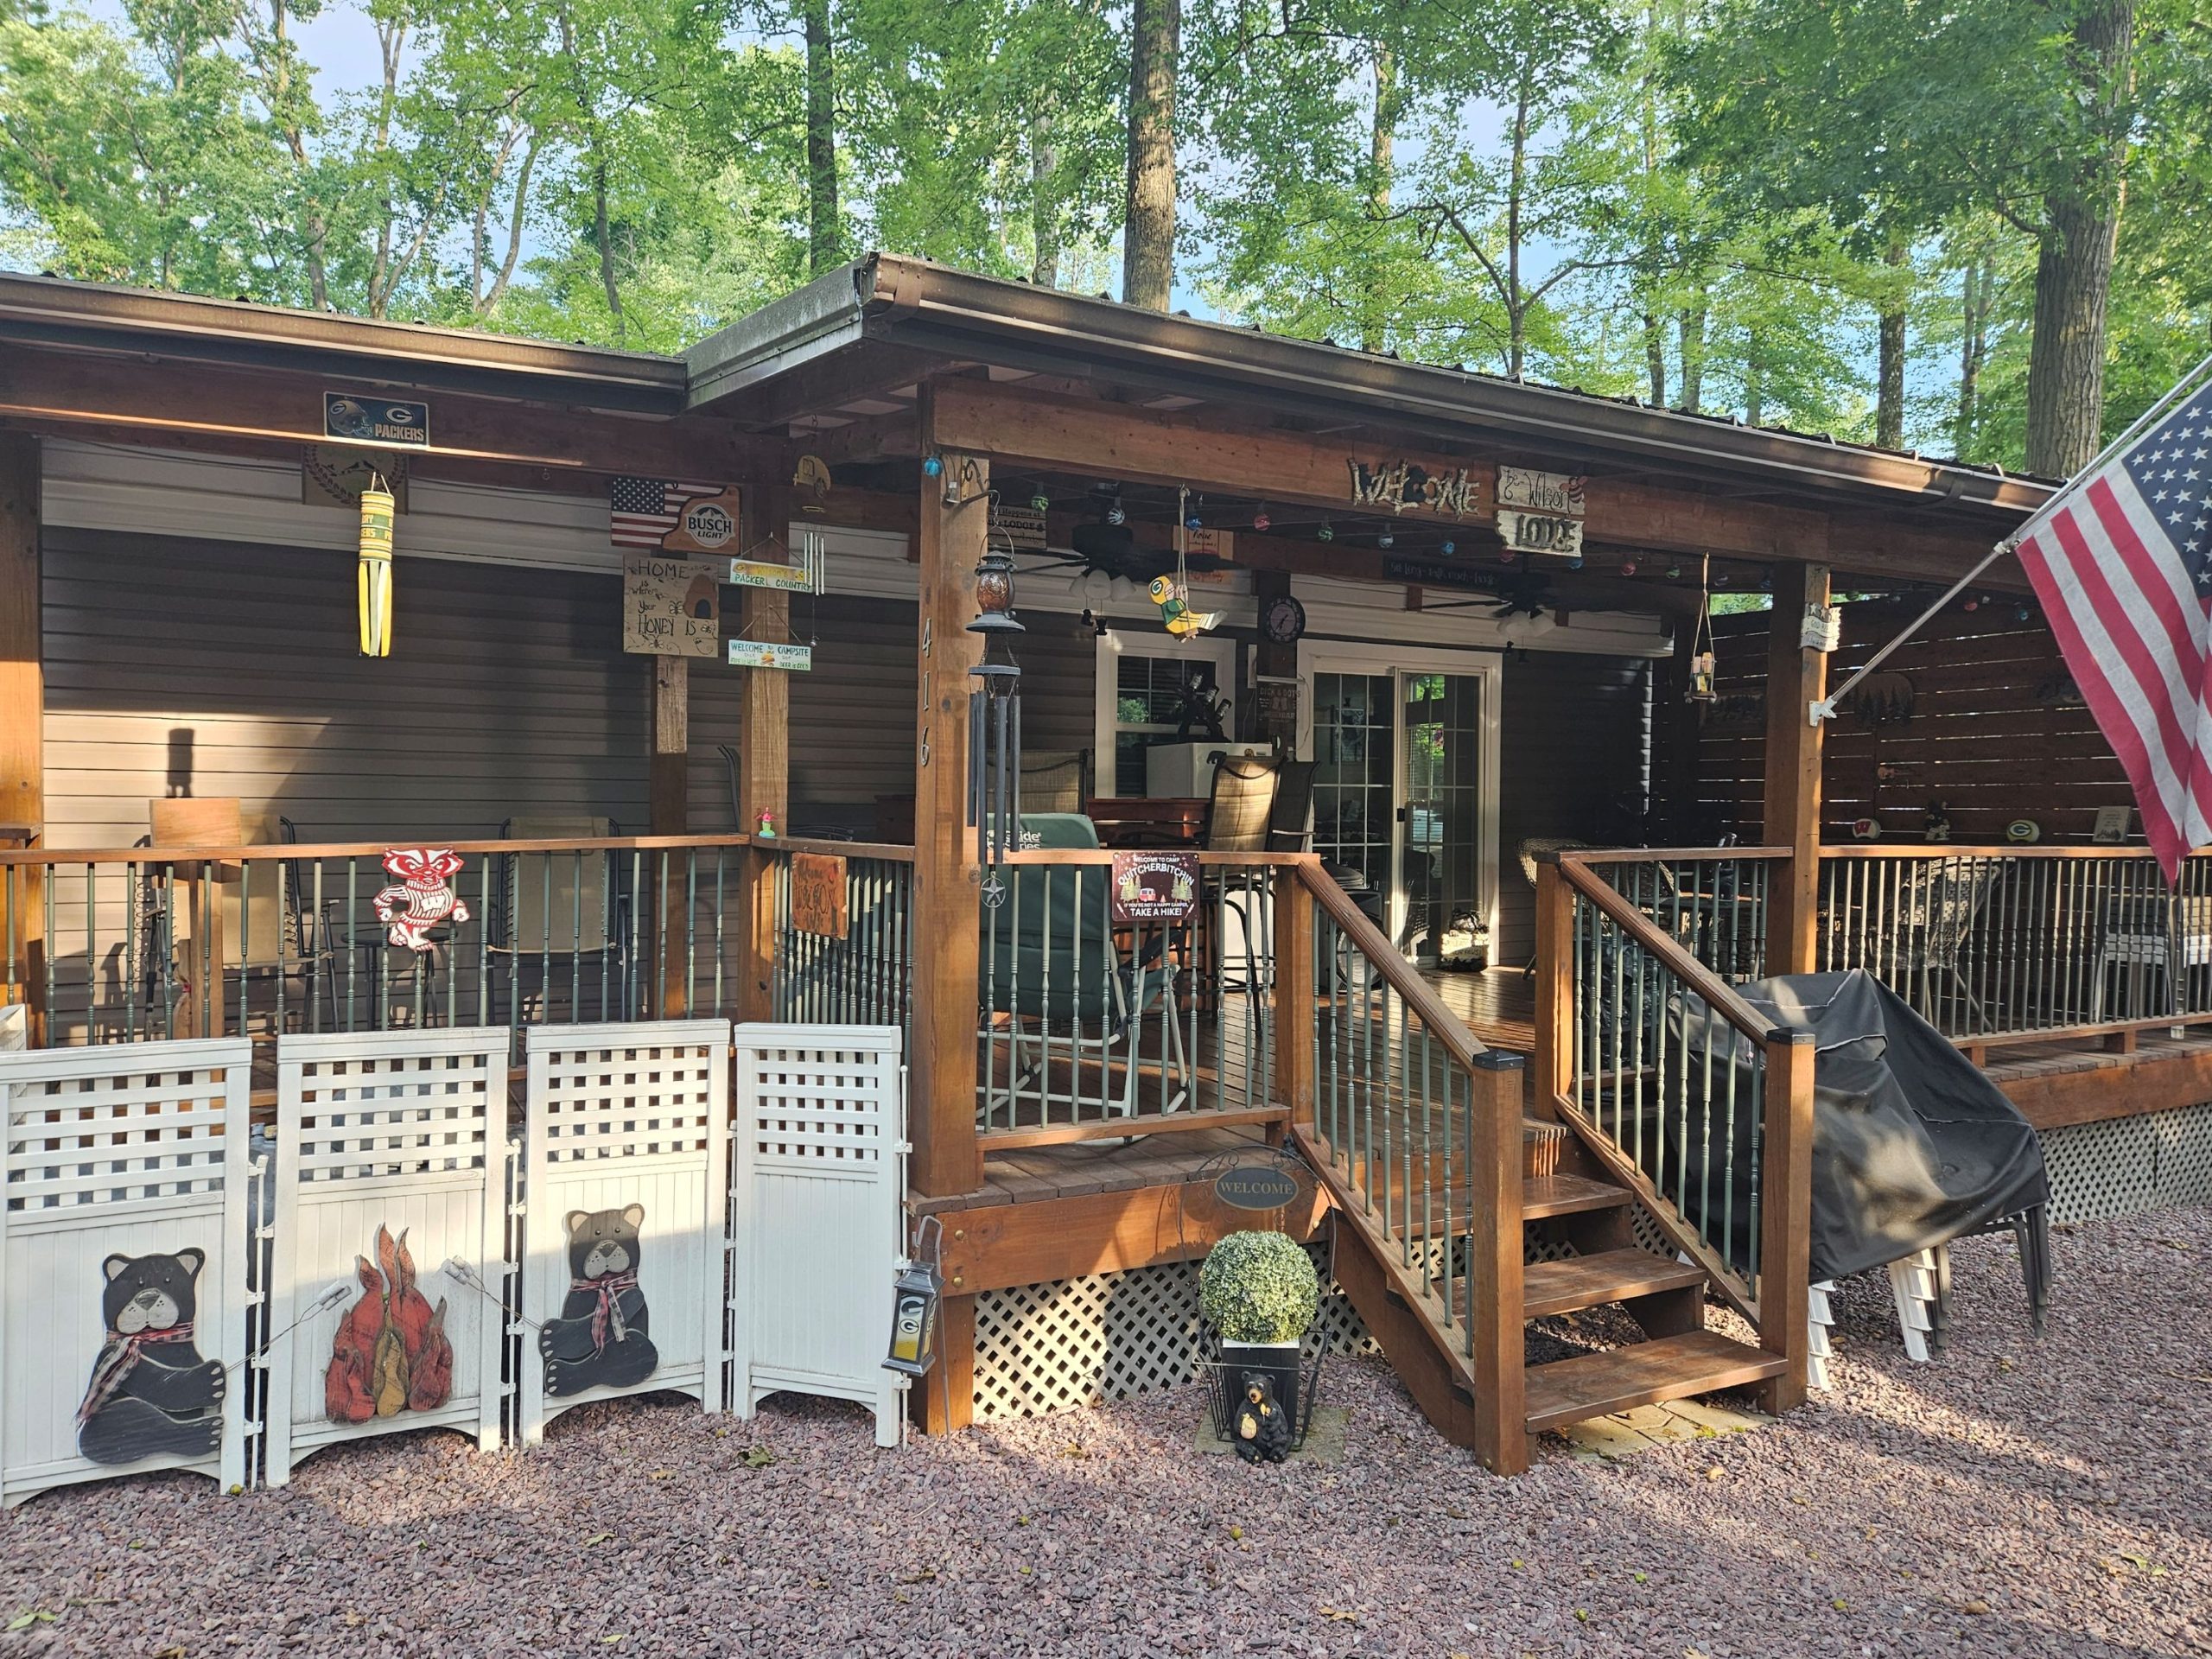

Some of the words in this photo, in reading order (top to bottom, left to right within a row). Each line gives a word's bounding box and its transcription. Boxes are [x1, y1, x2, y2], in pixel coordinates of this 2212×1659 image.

[374, 423, 424, 442] PACKERS
[1346, 458, 1480, 522] WELCOME
[1523, 472, 1571, 514] Wilson
[688, 516, 732, 533] BUSCH
[697, 531, 723, 539] LIGHT
[638, 559, 690, 579] HOME
[734, 574, 766, 586] PACKER
[775, 579, 811, 592] COUNTRY
[638, 613, 675, 637] HONEY
[684, 620, 696, 636] IS
[730, 642, 764, 654] WELCOME
[777, 646, 810, 657] CAMPSITE
[1117, 862, 1195, 887] QUITCHERBITCHIN
[1130, 908, 1152, 917] TAKE
[1160, 907, 1182, 916] HIKE!
[1220, 1181, 1294, 1195] WELCOME
